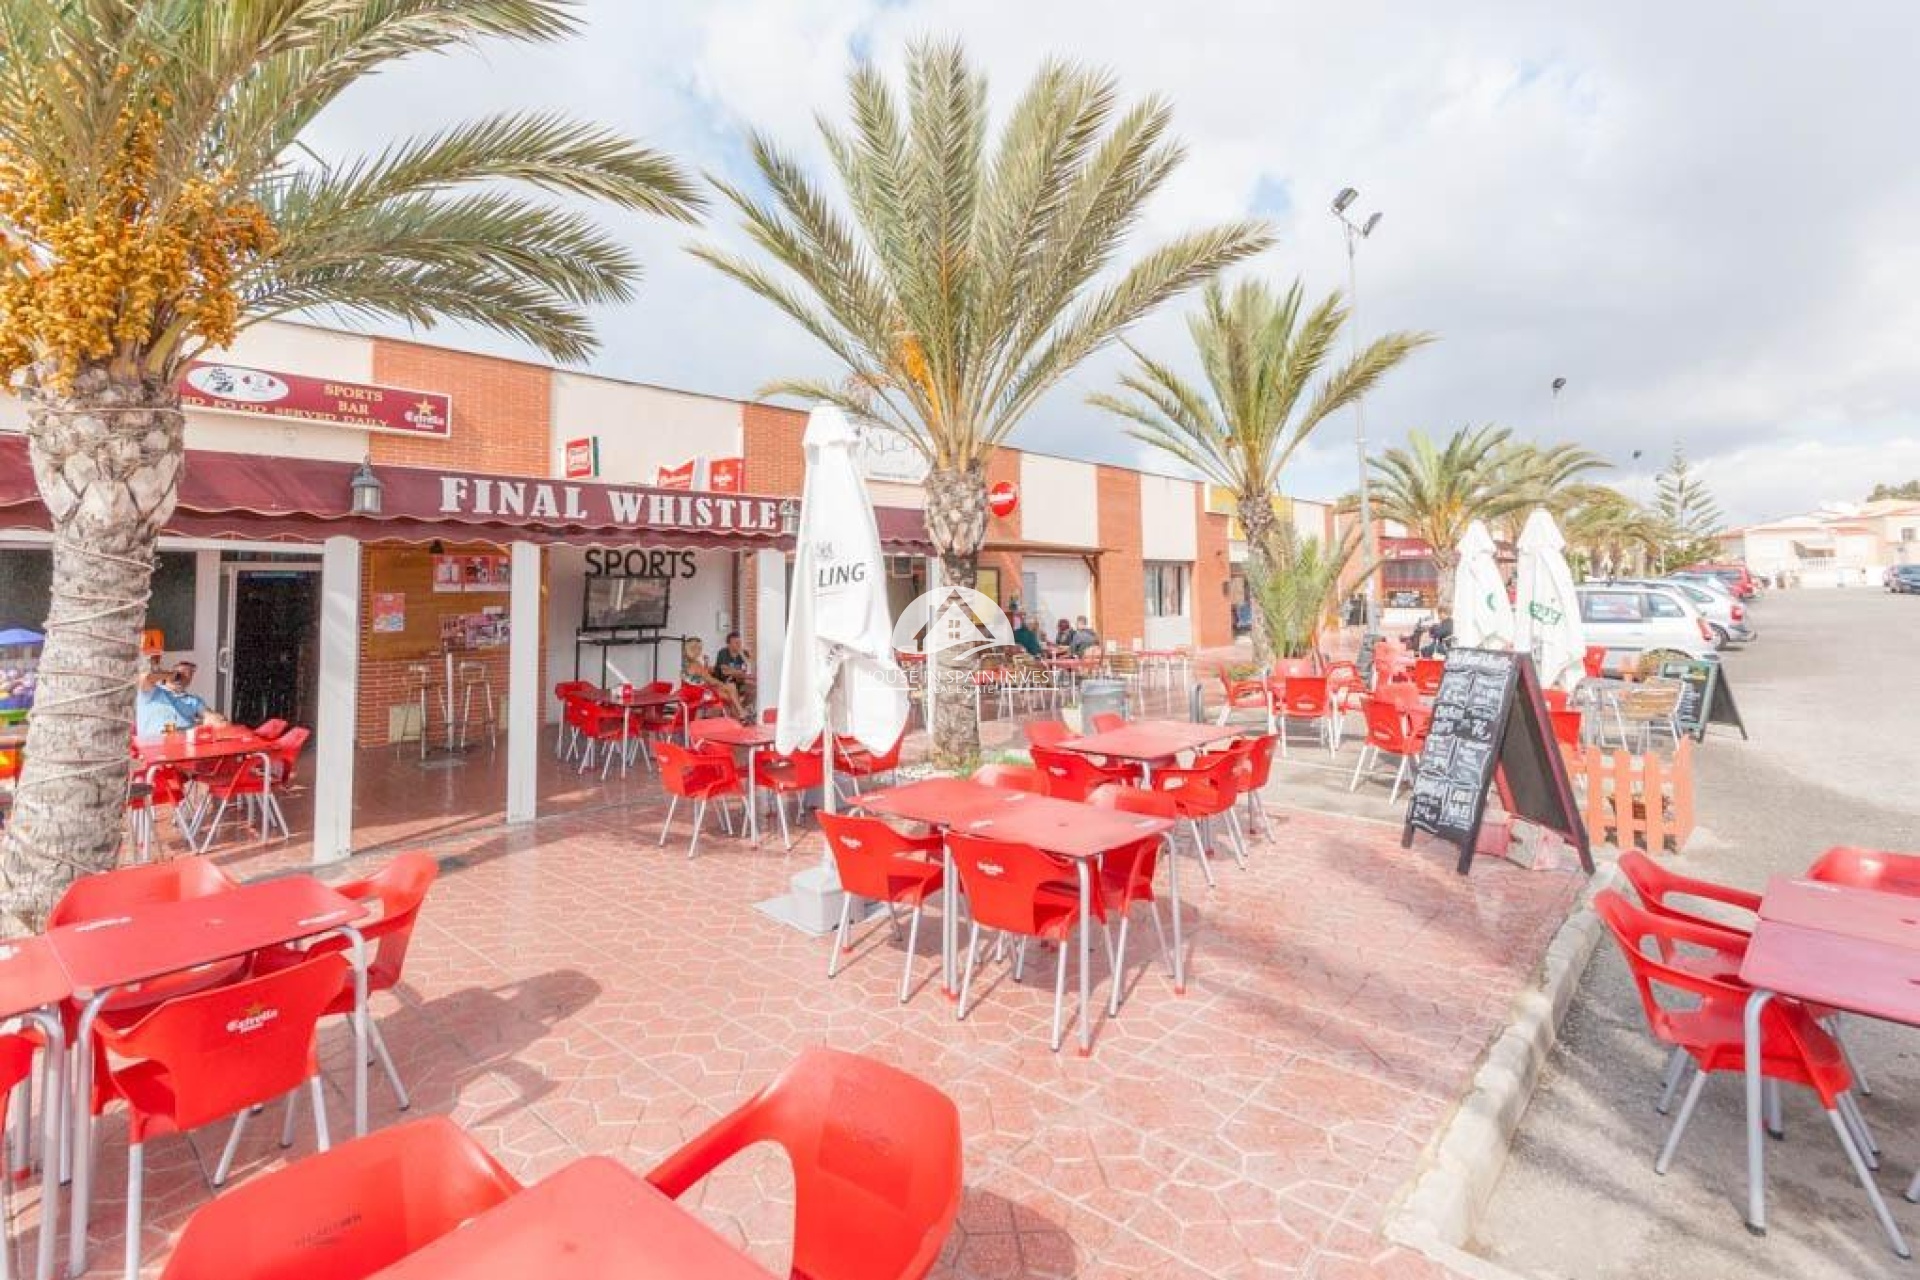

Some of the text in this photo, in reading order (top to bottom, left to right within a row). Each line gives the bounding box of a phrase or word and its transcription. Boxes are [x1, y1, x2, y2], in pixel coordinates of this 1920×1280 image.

[323, 383, 384, 402] SPORTS
[338, 400, 370, 415] BAR
[439, 476, 777, 529] FINAL WHISTLE
[584, 549, 697, 580] SPORTS
